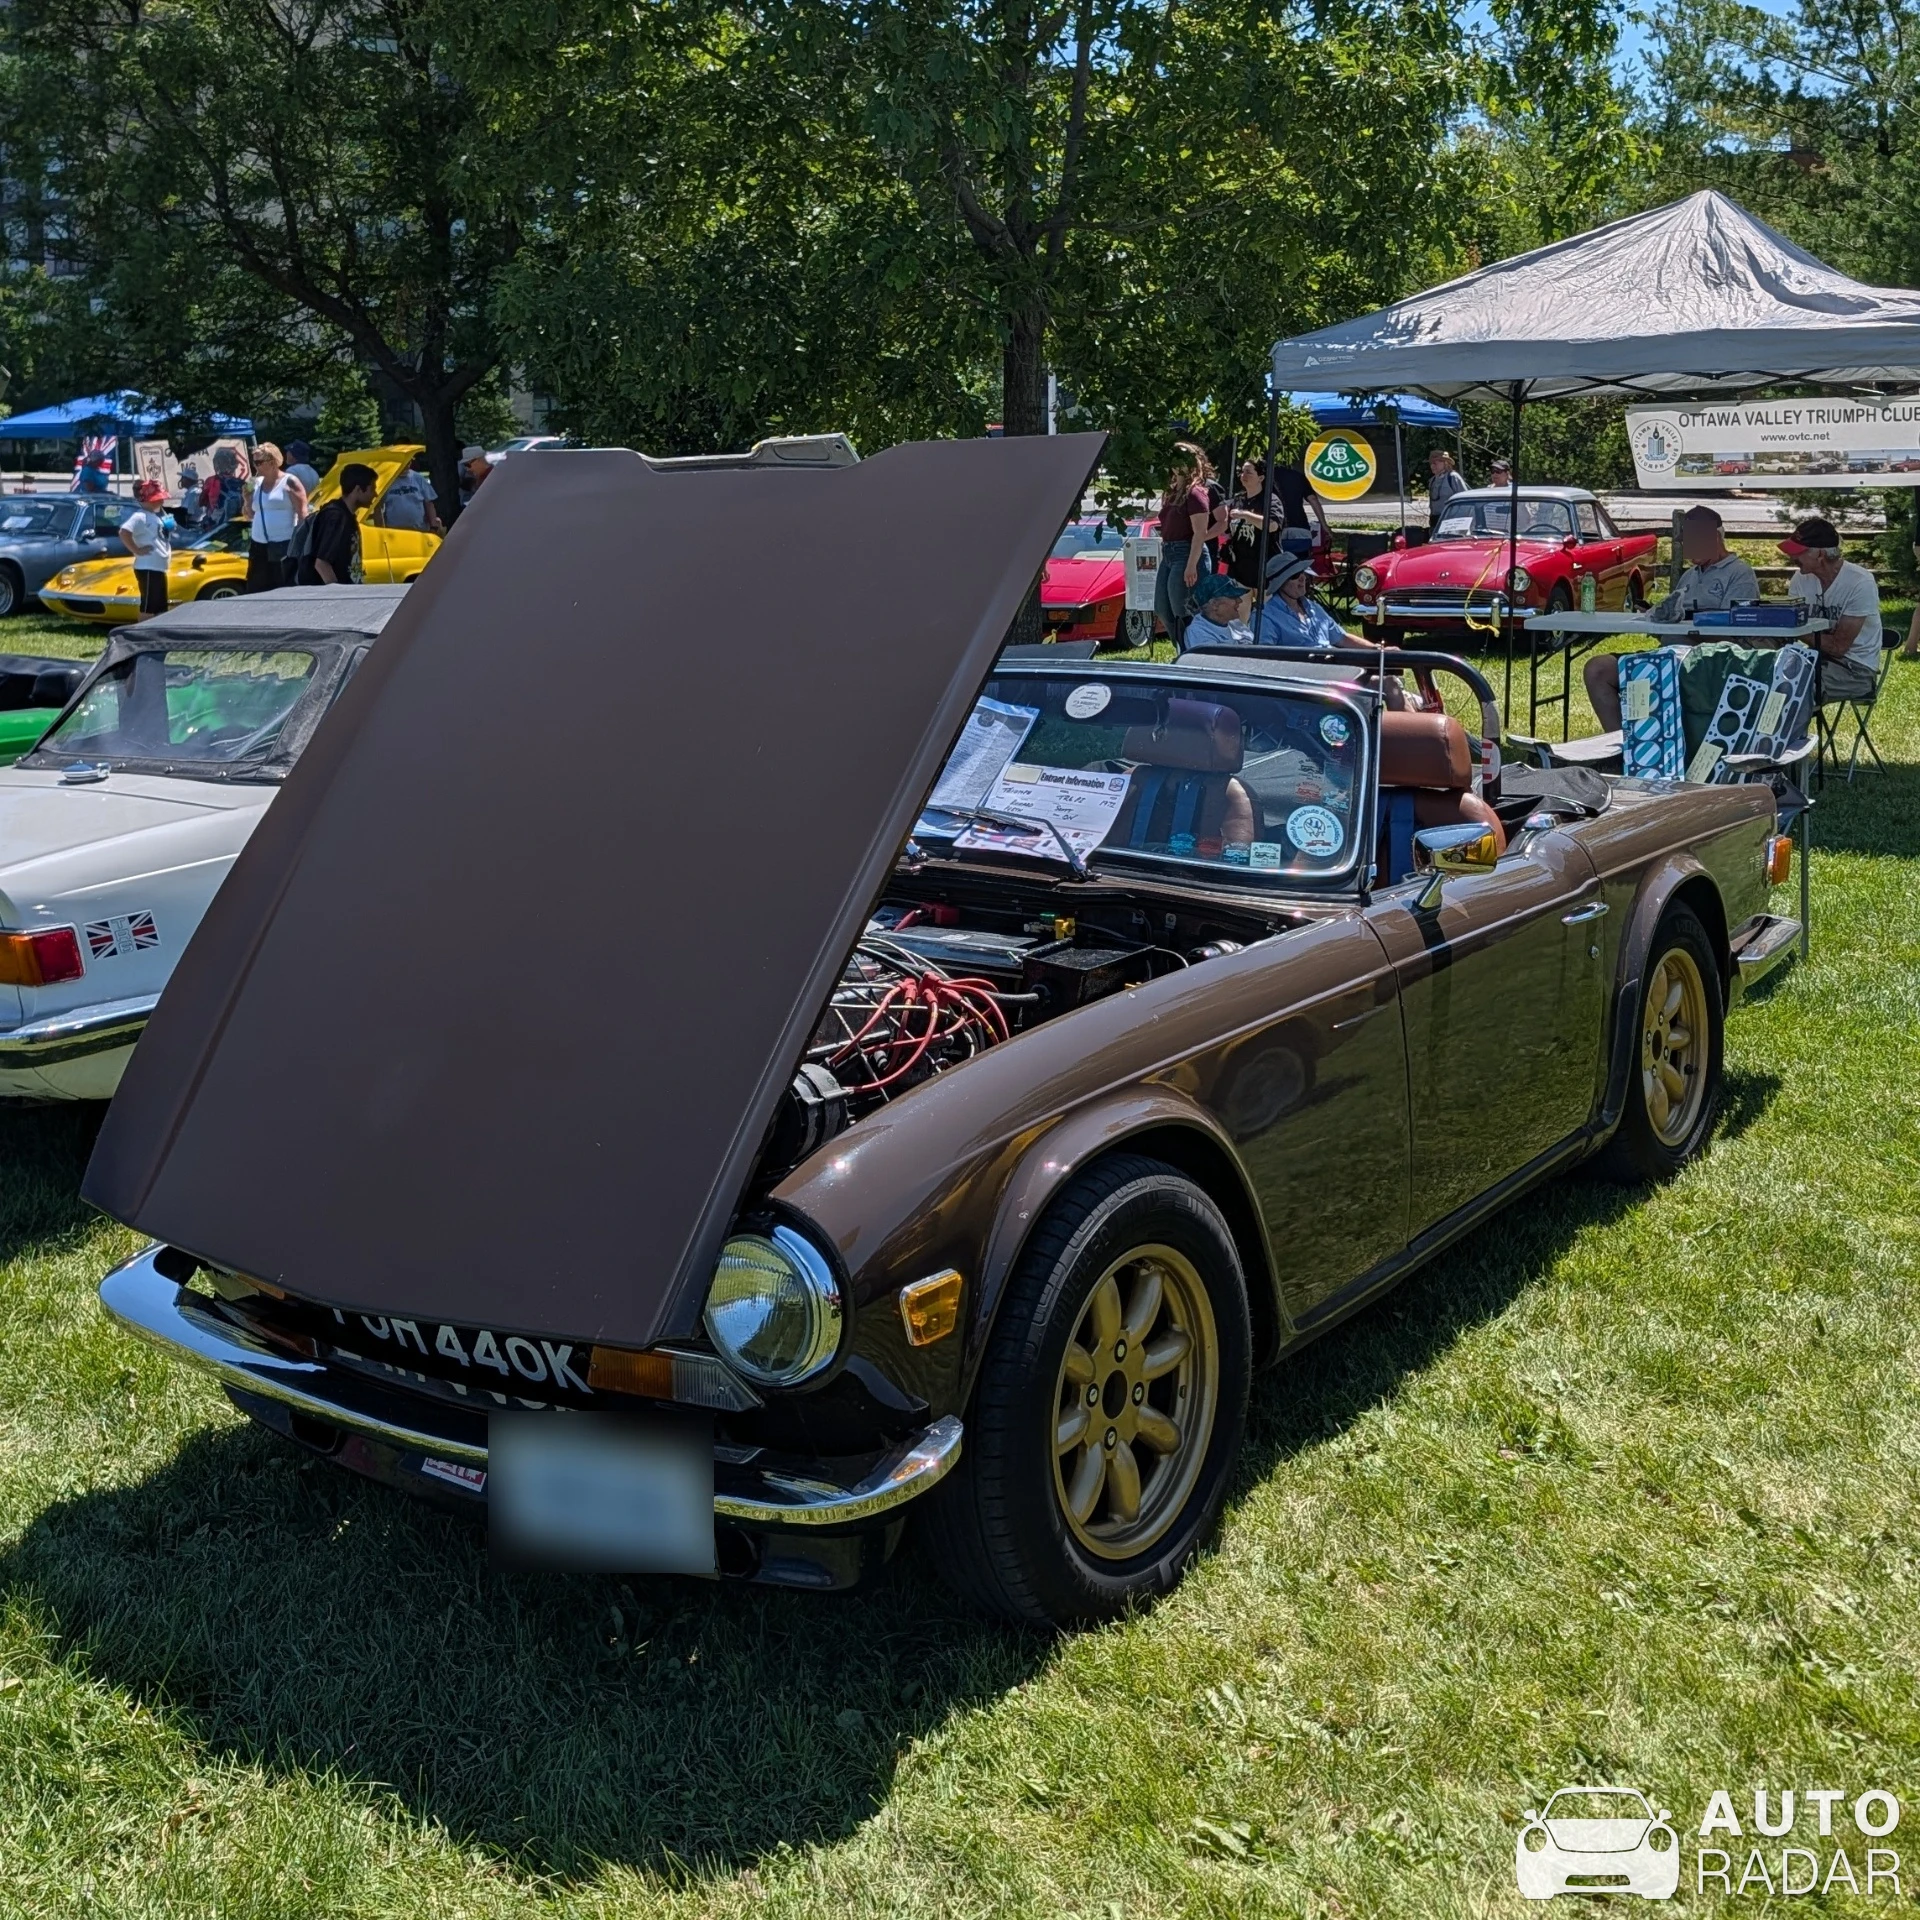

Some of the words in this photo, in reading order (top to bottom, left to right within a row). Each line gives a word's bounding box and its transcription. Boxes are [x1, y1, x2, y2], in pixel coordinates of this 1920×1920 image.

[1678, 411, 1741, 427] OTTAWA
[1745, 409, 1802, 425] VALLEY
[1806, 407, 1877, 424] TRIUMPH
[1760, 431, 1830, 442] www.ovtc.net
[1313, 460, 1367, 479] LOTUS
[1040, 772, 1065, 784] Entrant
[1065, 775, 1105, 789] Information
[1289, 808, 1320, 826] Parachute
[1289, 825, 1304, 846] British
[1320, 810, 1340, 845] Association
[435, 1325, 595, 1395] 440K
